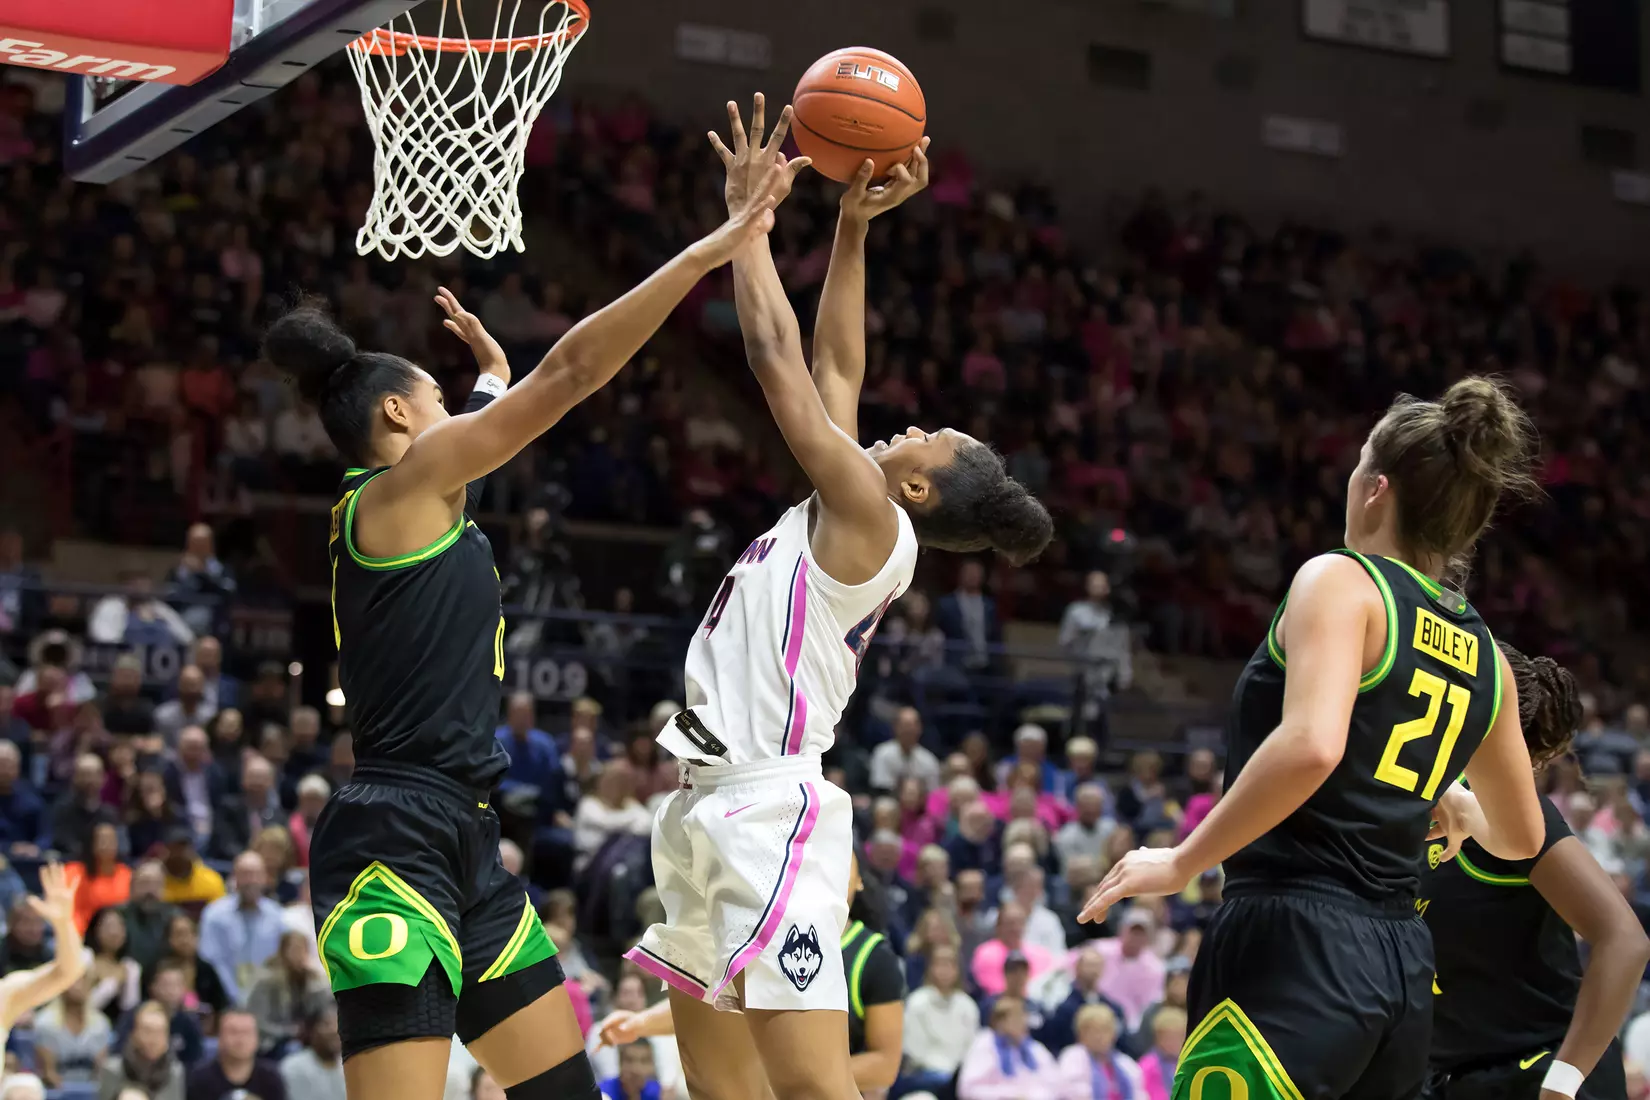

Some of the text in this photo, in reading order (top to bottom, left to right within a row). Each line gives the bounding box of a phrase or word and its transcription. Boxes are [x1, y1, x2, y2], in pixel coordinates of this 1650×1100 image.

[0, 38, 177, 80] Farm
[1421, 616, 1474, 666] BOLEY
[513, 657, 588, 699] 109
[1373, 667, 1471, 801] 21
[348, 912, 409, 960] O
